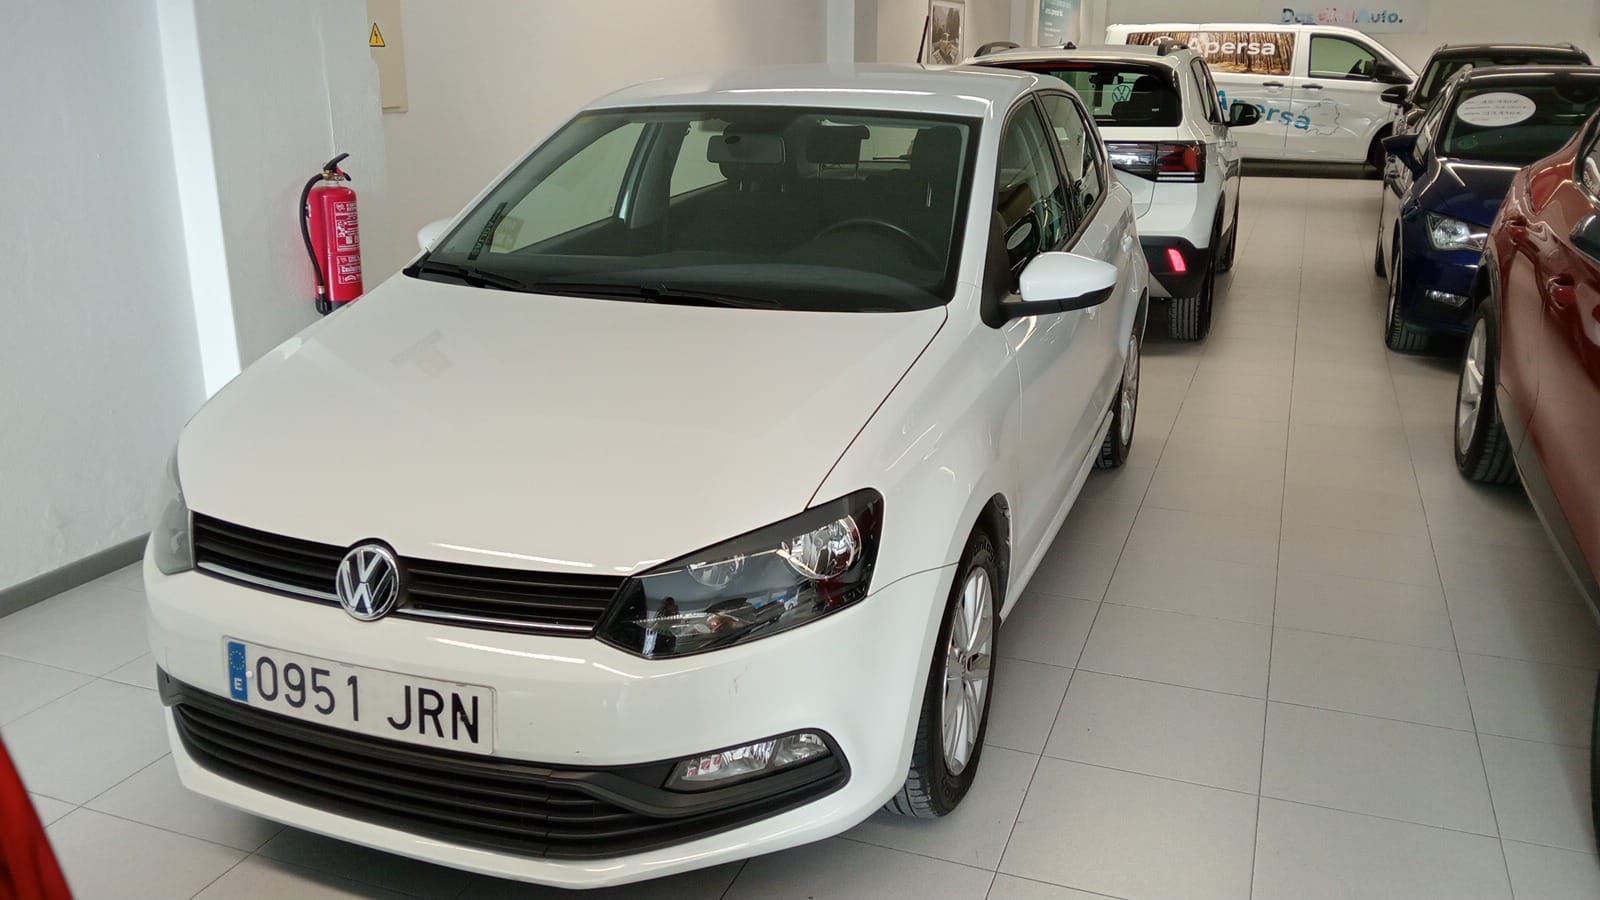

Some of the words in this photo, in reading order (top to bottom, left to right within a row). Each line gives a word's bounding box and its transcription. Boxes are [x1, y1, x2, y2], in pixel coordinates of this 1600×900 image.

[1187, 36, 1276, 58] Apersa
[233, 677, 243, 692] E
[256, 656, 359, 722] 0951
[387, 684, 479, 744] JRN
